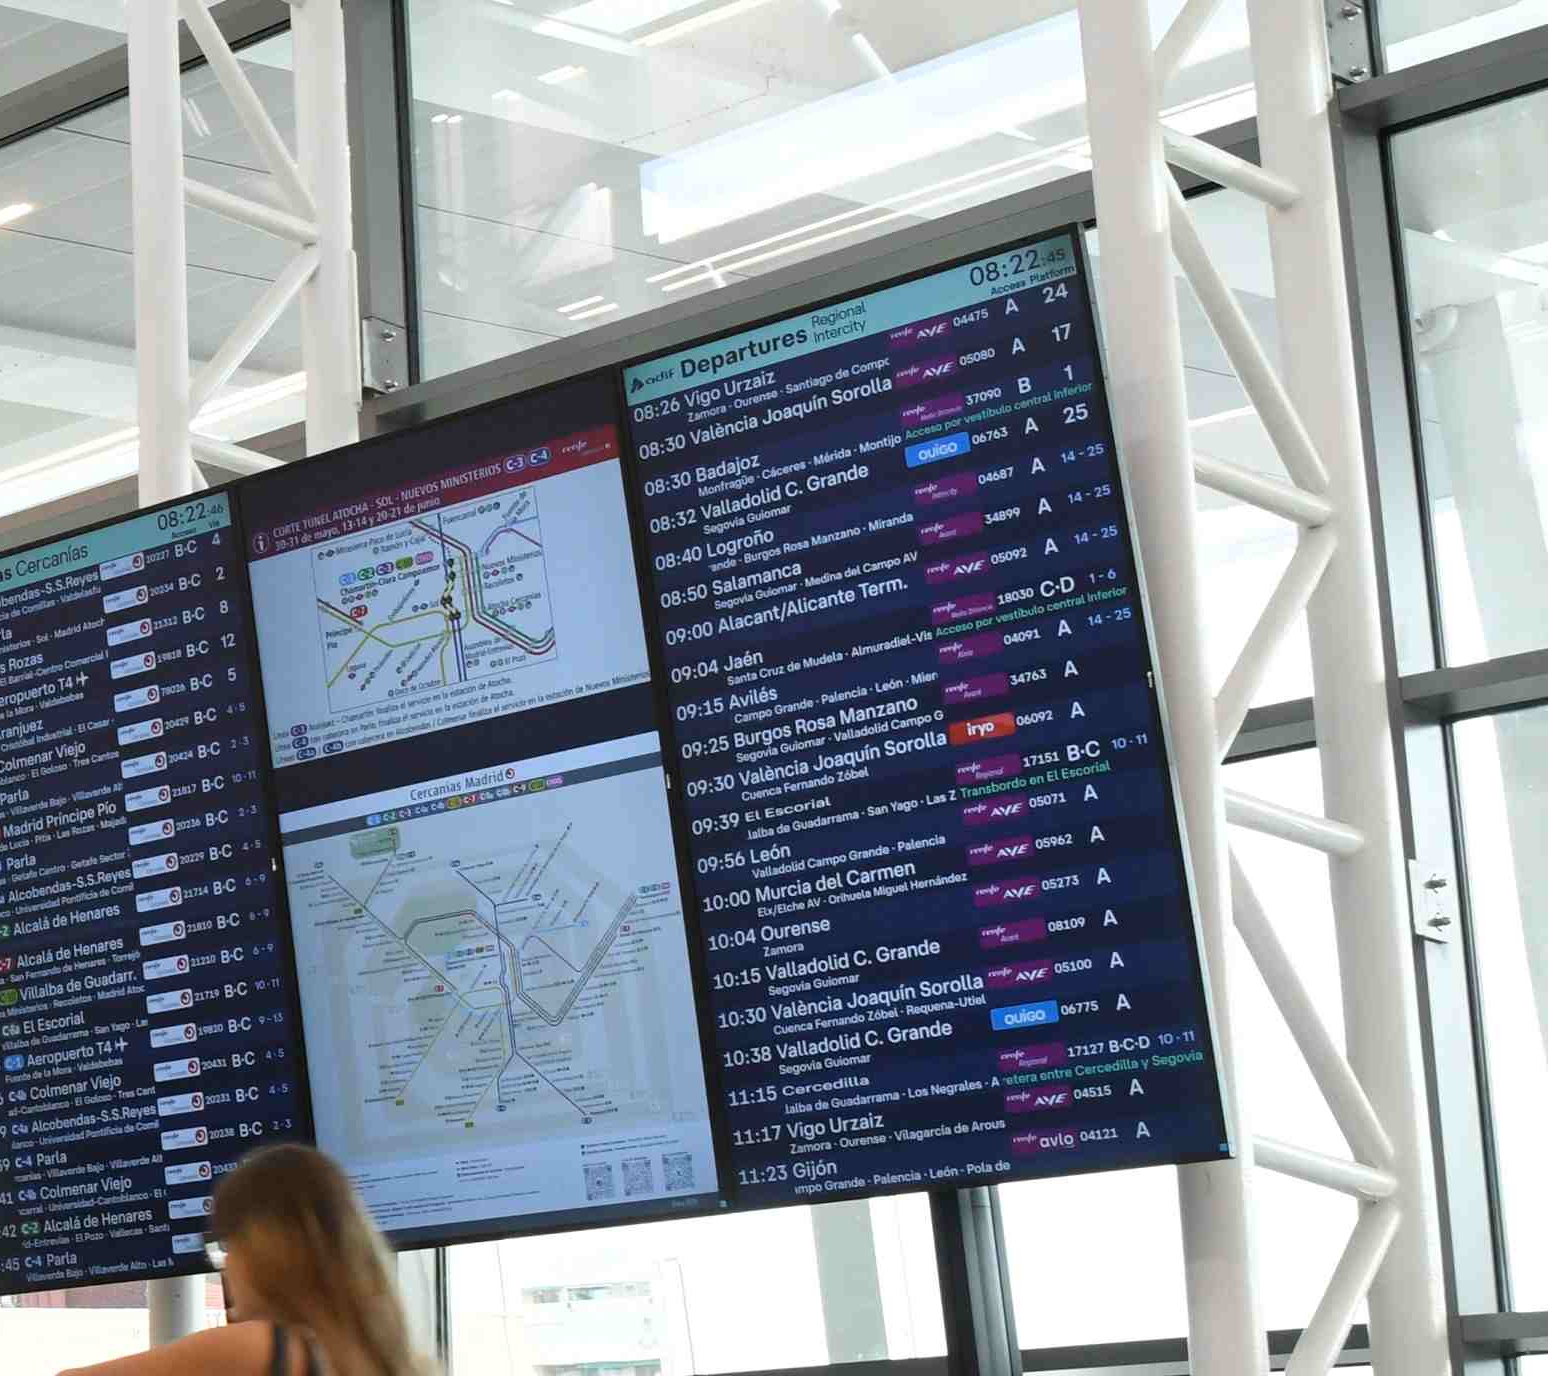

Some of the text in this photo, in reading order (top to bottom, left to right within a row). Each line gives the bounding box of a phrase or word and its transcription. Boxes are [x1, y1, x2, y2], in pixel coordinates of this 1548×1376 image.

[989, 260, 1073, 295] Access Platform
[809, 299, 867, 328] Regional
[812, 319, 866, 344] Intercity
[632, 281, 1069, 423] 08:26 Vigo Urzaiz 04475 A 24
[679, 328, 808, 379] Departures
[638, 321, 1071, 460] 08:30 València Joaquín Sorolla 05080 A 17
[643, 454, 761, 497] 08:30 Badajoz
[648, 507, 697, 534] 08:32
[699, 483, 782, 520] Valladolid
[783, 480, 803, 497] C.
[805, 462, 869, 492] Grande
[970, 425, 1008, 445] 06763
[1023, 416, 1039, 435] A
[1062, 401, 1089, 424] 25
[697, 433, 902, 497] Monfragüe Cáceres Mérida Montijo
[330, 502, 369, 524] ATOCHA
[375, 494, 393, 510] SOL
[401, 482, 439, 502] NUEVOS
[441, 463, 502, 489] MINISTERIOS
[530, 450, 549, 465] C-4
[404, 501, 416, 514] de
[702, 503, 791, 535] Segovia Guiomar
[14, 543, 89, 577] Cercanías
[654, 528, 775, 571] 08:40 Logroño
[659, 562, 802, 609] 08:50 Salamanca
[664, 577, 909, 646] 09:00 Alacant/Alicante Term.
[7, 652, 44, 672] Rozas
[670, 649, 764, 684] 09:04 Jaén
[55, 675, 74, 691] T4
[675, 685, 778, 721] 09:15 Avilés
[680, 696, 918, 759] 09:25 Burgos Rosa Manzano
[53, 740, 86, 759] Viejo
[686, 721, 995, 797] 09:30 València Joaquín Sorolla iryo
[464, 766, 505, 791] Madrid
[740, 765, 870, 802] Cuenca Fernando Zóbel
[958, 759, 1111, 799] Transbordo en El Escorial
[2, 799, 117, 838] Madrid Príncipe Pío
[690, 795, 832, 836] 09:39 El Escorial
[696, 842, 792, 874] 09:56 León
[750, 833, 946, 879] Valladolid Campo Grande Palencia
[702, 862, 916, 912] 10:00 Murcia del Carmen
[12, 914, 50, 936] Alcalá
[51, 913, 68, 928] de
[68, 903, 121, 924] Henares
[707, 918, 831, 951] 10:04 Ourense
[712, 937, 941, 990] 10:15 Valladolid C. Grande
[762, 942, 805, 958] Zamora
[18, 982, 64, 1001] Villalba
[65, 977, 82, 993] de
[82, 969, 137, 989] Guadarr.
[22, 1018, 36, 1035] El
[36, 1009, 85, 1032] Escorial
[727, 1075, 870, 1107] 11:15 Cercedilla
[732, 1111, 885, 1146] 11:17 Vigo Urzaiz
[737, 1131, 1074, 1185] 11:23 Gijón avlo
